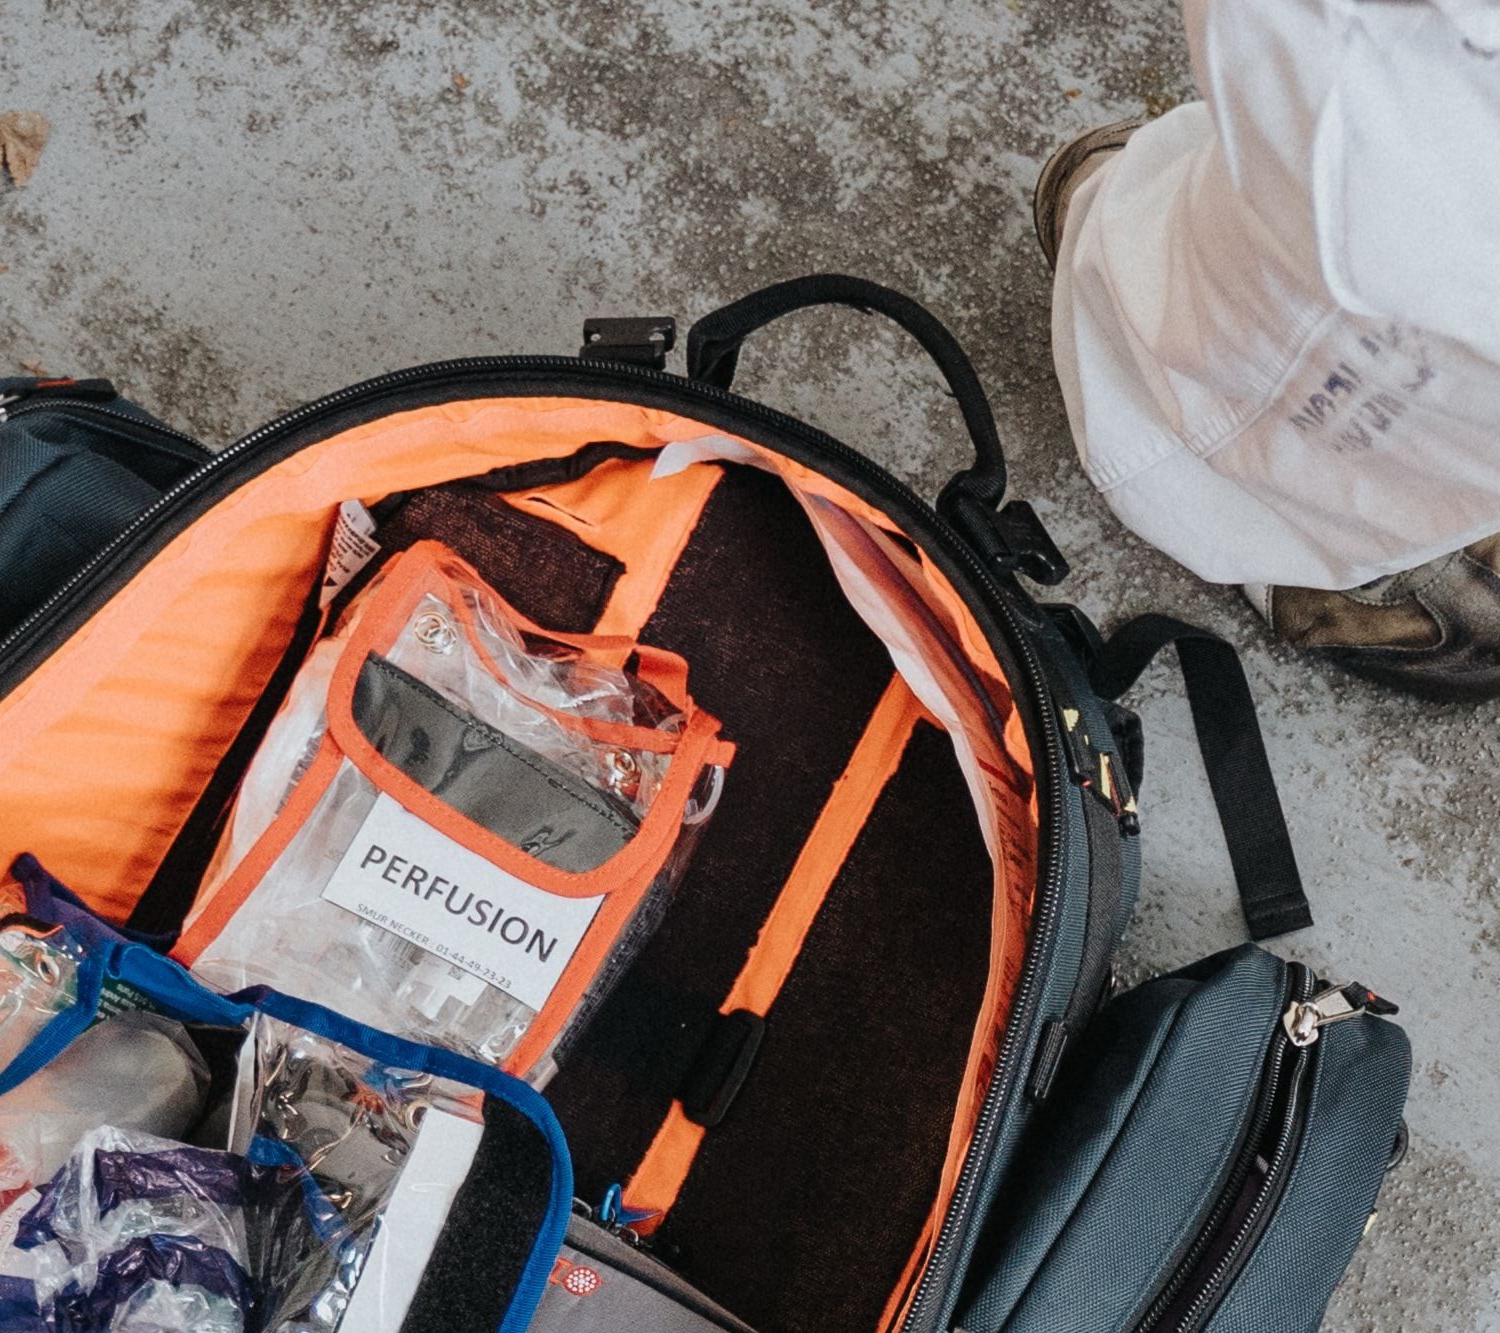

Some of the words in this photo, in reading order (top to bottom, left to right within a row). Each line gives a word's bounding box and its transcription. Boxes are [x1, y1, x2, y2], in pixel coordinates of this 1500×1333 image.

[355, 902, 389, 924] SMUR
[388, 918, 430, 946] NECKER
[435, 942, 512, 989] 01-44-49-23-23
[360, 841, 558, 963] PERFUSION
